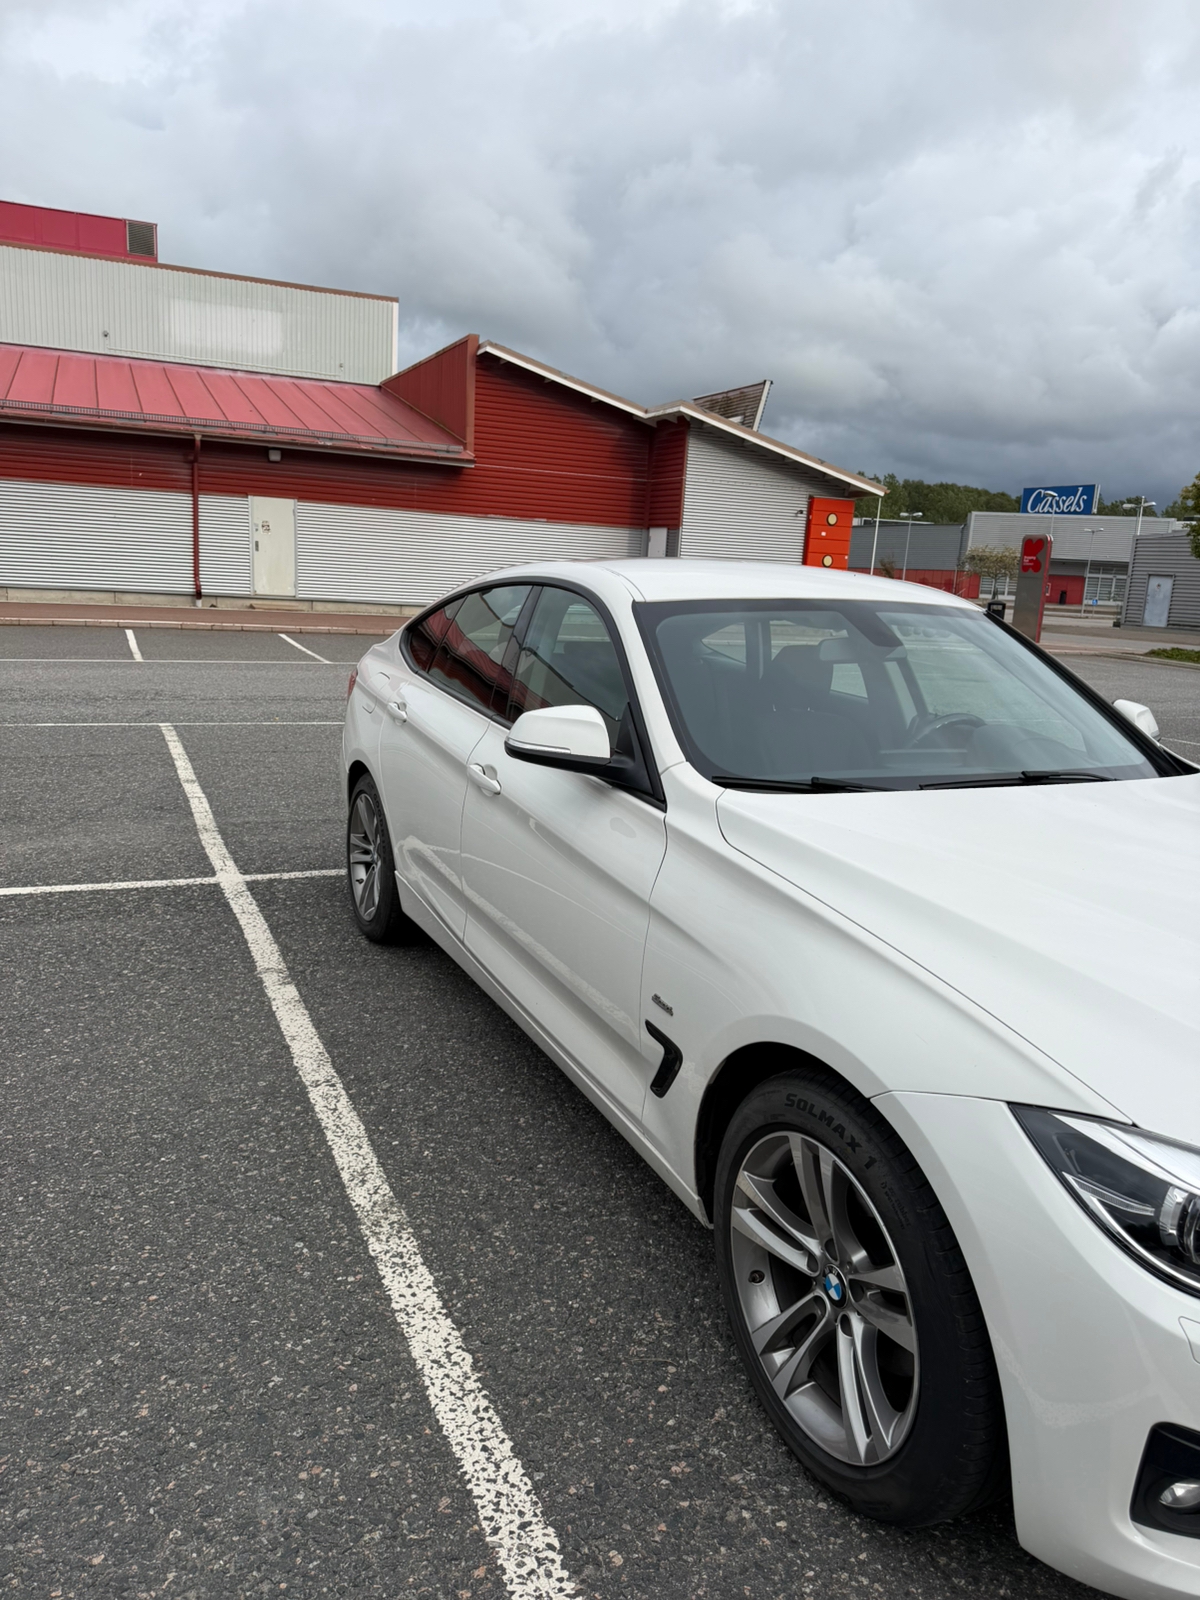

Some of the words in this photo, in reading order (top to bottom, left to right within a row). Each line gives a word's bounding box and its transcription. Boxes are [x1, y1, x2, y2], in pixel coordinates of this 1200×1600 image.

[1027, 487, 1087, 513] Cassels
[784, 1093, 862, 1154] SOLMAX
[864, 1156, 877, 1170] 1
